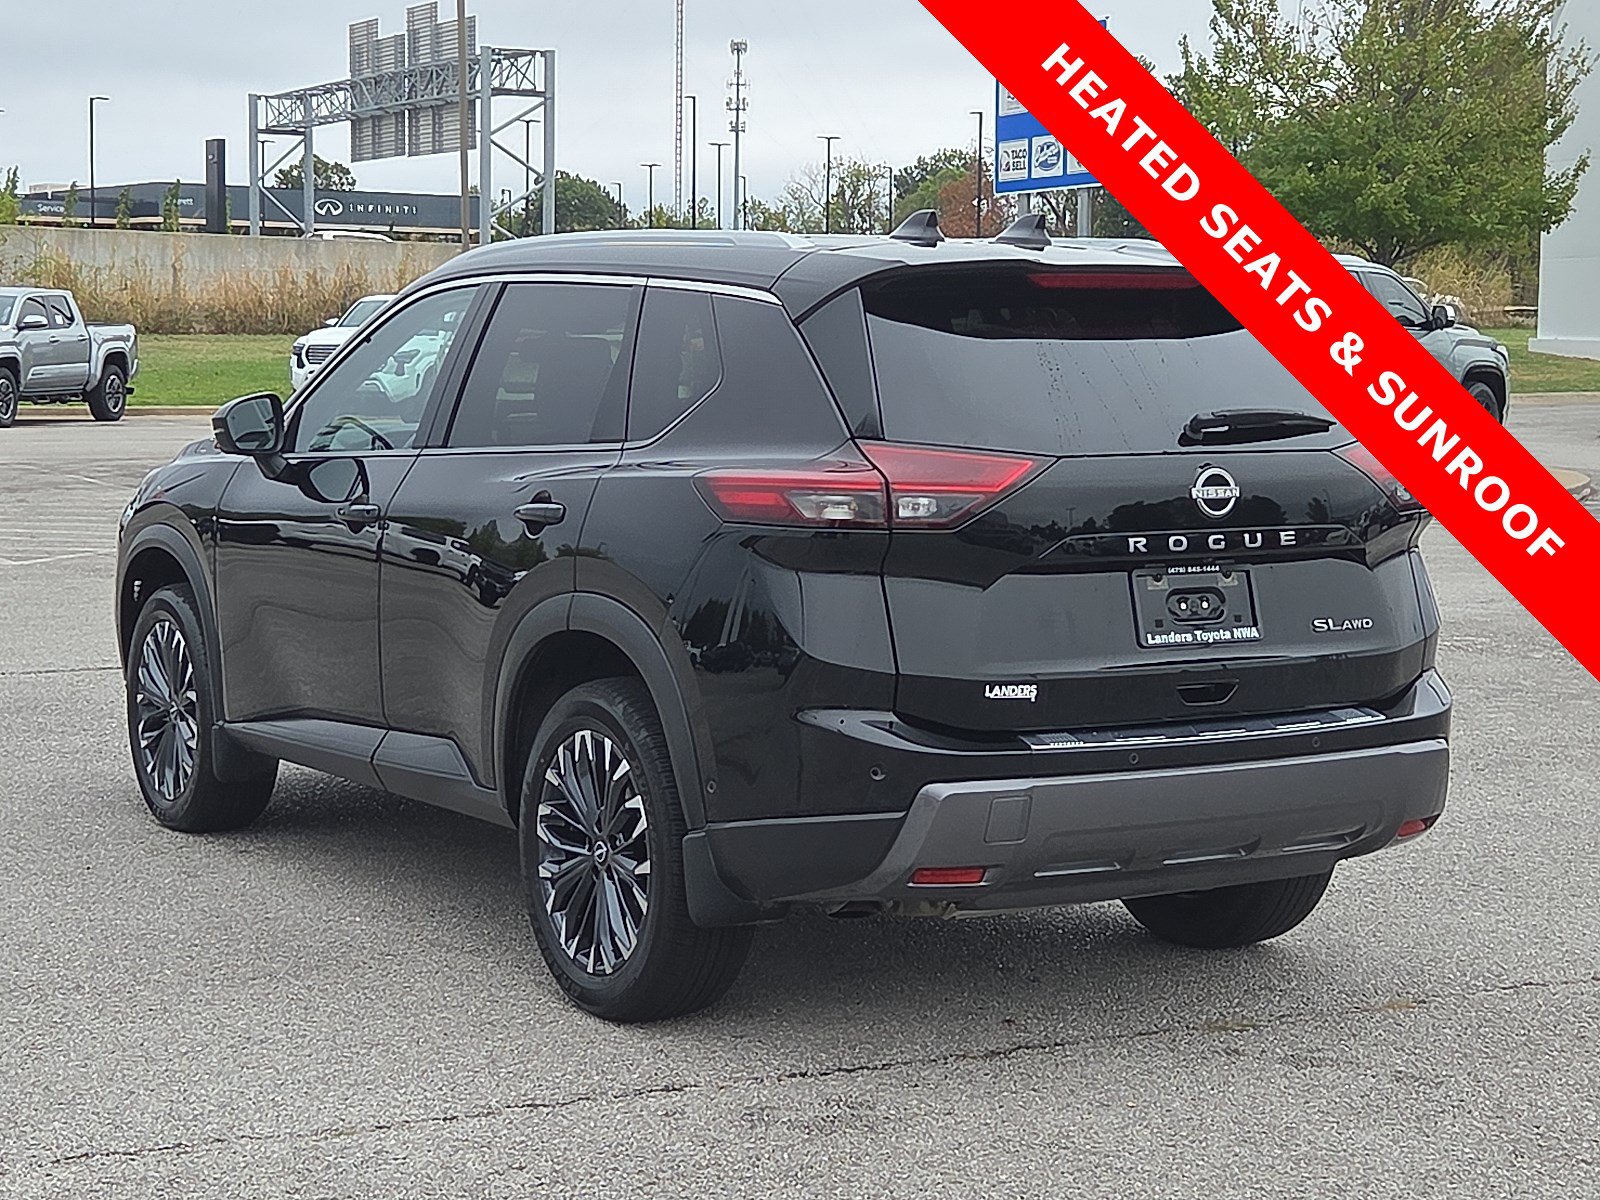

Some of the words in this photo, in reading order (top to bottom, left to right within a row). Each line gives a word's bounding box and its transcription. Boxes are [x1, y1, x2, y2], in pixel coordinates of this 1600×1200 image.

[1011, 148, 1028, 160] TACO
[37, 203, 65, 213] Service
[349, 203, 418, 215] INFINITI
[1192, 487, 1239, 499] NISSAN
[1128, 531, 1297, 553] ROGUE
[1147, 632, 1193, 645] Landers
[1194, 629, 1232, 643] Toyota
[1233, 627, 1260, 639] NWA
[984, 684, 1038, 702] LANDERS
